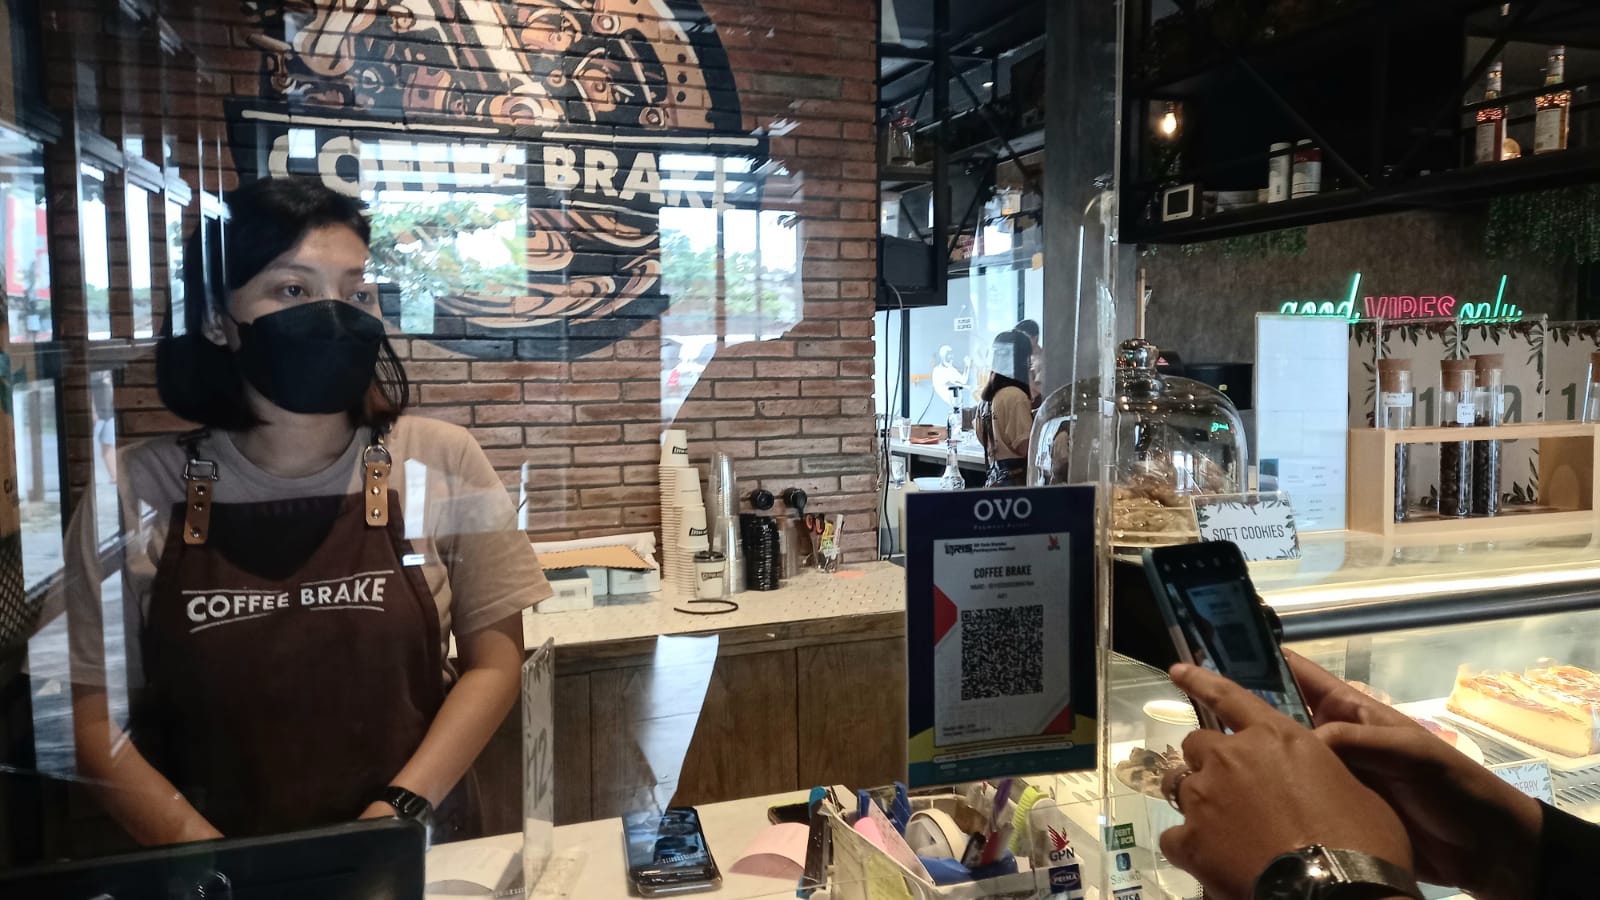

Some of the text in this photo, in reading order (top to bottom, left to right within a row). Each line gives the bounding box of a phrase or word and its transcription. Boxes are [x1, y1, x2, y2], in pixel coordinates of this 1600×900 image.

[1365, 296, 1456, 317] VIBES
[974, 497, 1032, 521] OVO
[1212, 524, 1285, 541] SOFT COOKIES
[974, 564, 1032, 579] COFFEE BRAKE
[187, 577, 386, 622] COFFEE BRAKE
[1049, 847, 1075, 862] GPN
